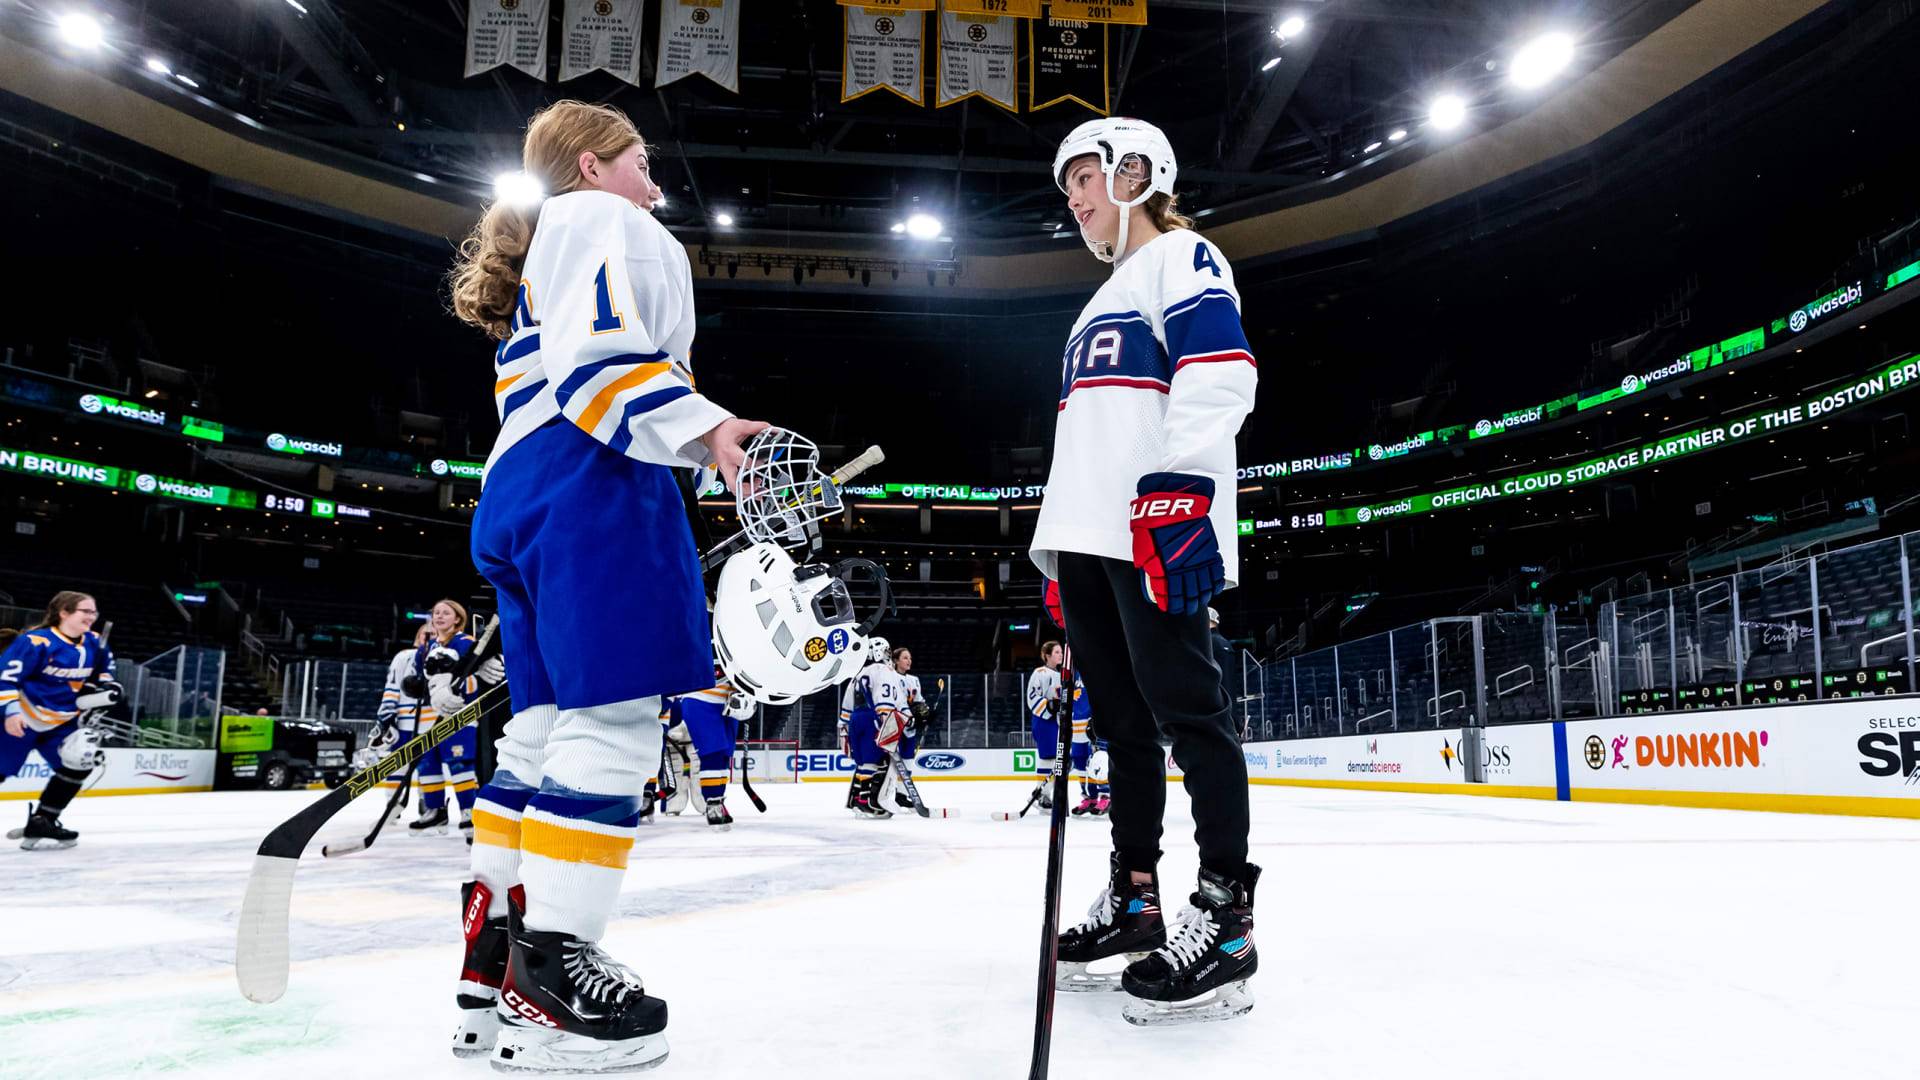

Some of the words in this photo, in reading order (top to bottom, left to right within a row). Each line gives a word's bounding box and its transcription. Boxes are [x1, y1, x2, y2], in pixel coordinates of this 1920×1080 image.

[982, 0, 1007, 11] 1972
[1088, 7, 1112, 18] 2011
[576, 24, 629, 32] CHAMPIONS
[582, 16, 622, 24] DIVISION
[1048, 17, 1089, 29] BRUINS
[673, 32, 724, 40] CHAMPIONS
[680, 25, 720, 33] DIVISION
[1053, 53, 1085, 61] TROPHY
[1193, 241, 1221, 278] 4
[591, 257, 625, 335] 1
[1809, 281, 1862, 320] wasabi
[1640, 356, 1691, 385] wasabi
[105, 403, 166, 425] wasabi
[1493, 407, 1541, 430] wasabi
[288, 439, 342, 456] wasabi
[1373, 500, 1412, 517] wasabi
[1431, 485, 1501, 508] OFFICIAL
[1504, 473, 1562, 495] CLOUD
[1566, 452, 1639, 483] STORAGE
[1643, 428, 1725, 464] PARTNER
[1729, 419, 1757, 438] OF
[1761, 406, 1802, 430] THE
[1808, 376, 1885, 418] BOSTON
[1385, 436, 1426, 453] wasabi
[23, 455, 108, 482] BRUINS
[450, 464, 483, 476] wasa
[1236, 462, 1287, 480] OSTON
[1291, 453, 1352, 473] BRUINS
[158, 480, 214, 498] wasabi
[844, 485, 883, 495] wasabi
[902, 486, 968, 499] OFFICIAL
[972, 486, 1022, 499] CLOUD
[264, 494, 305, 512] 8:50
[316, 501, 332, 514] TD
[337, 504, 371, 518] Bank
[1239, 522, 1252, 531] TD
[1256, 518, 1282, 529] Bank
[1291, 513, 1324, 529] 8:50
[881, 683, 898, 701] 30
[1635, 730, 1769, 768] DUNKIN'
[134, 754, 158, 769] Red
[160, 753, 188, 769] River
[786, 754, 857, 771] GEIC
[925, 755, 955, 768] Ford
[1015, 754, 1034, 769] TD
[1347, 760, 1401, 773] demandscience
[464, 891, 484, 934] CCM
[504, 989, 557, 1028] CCM
